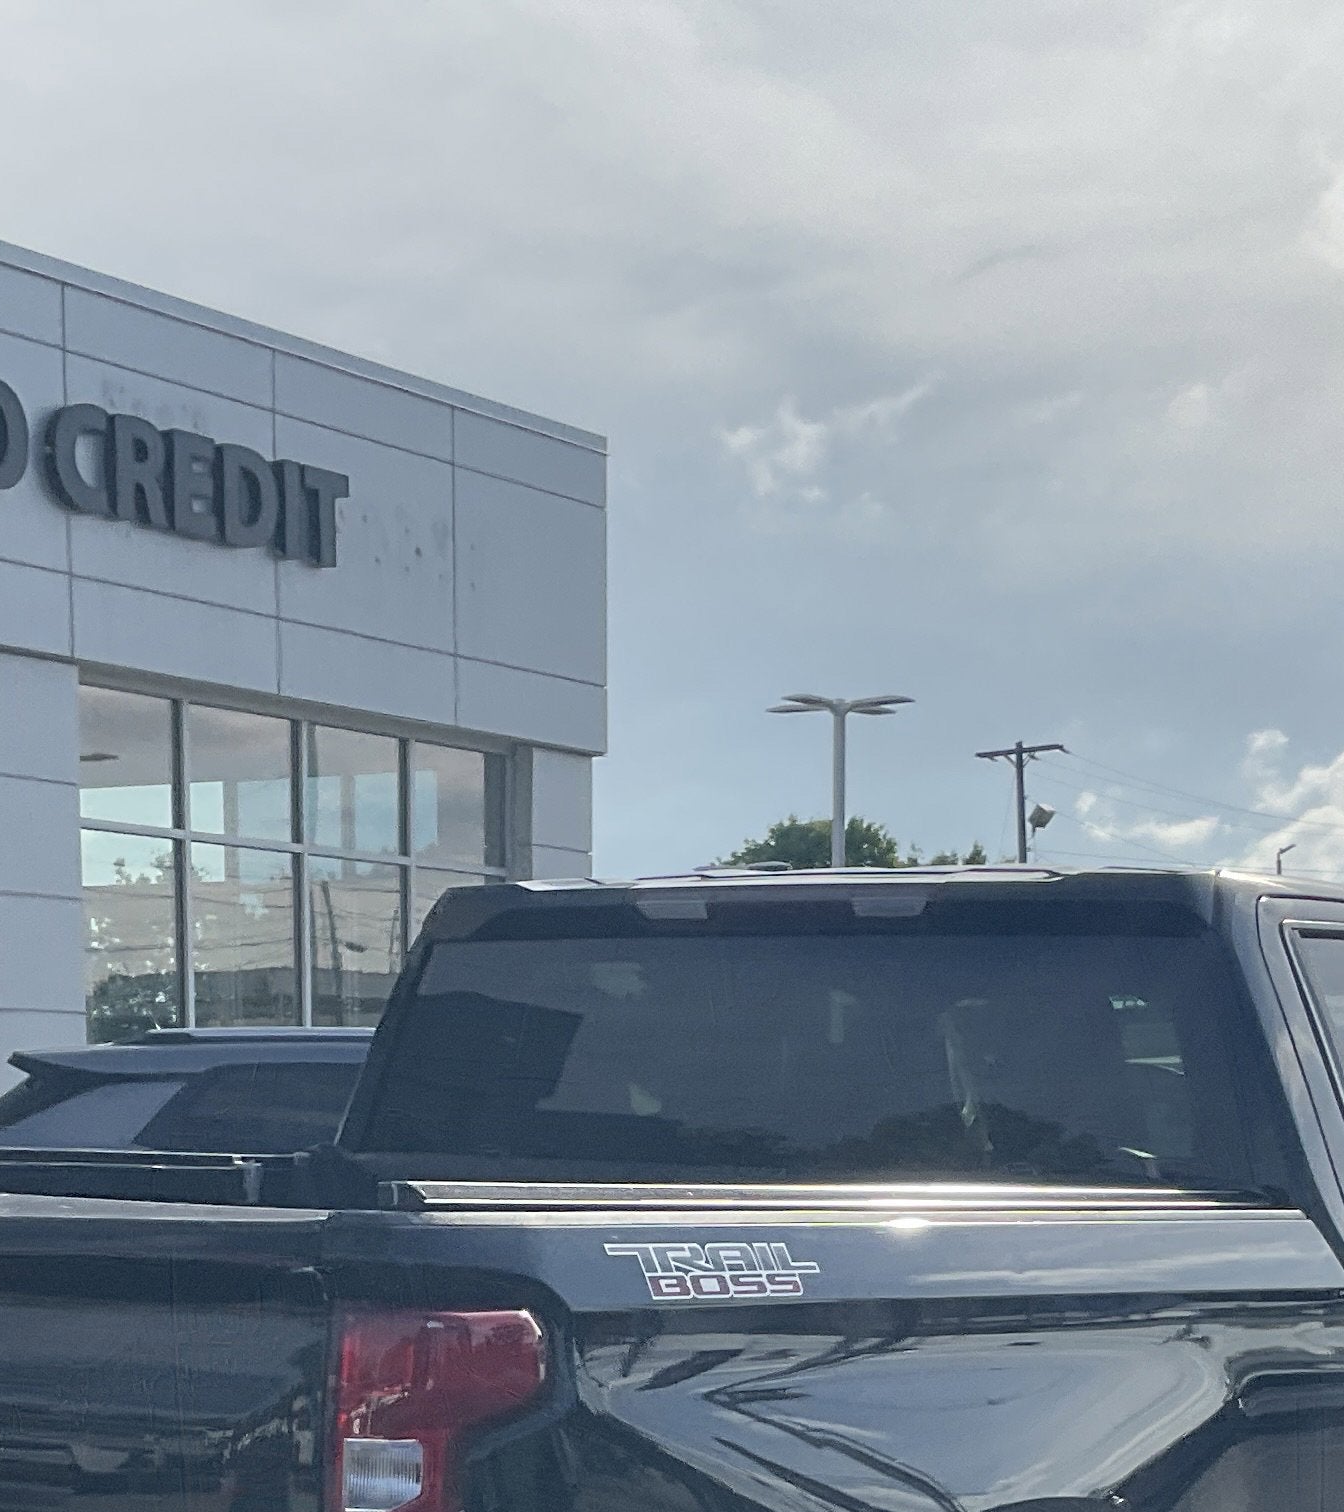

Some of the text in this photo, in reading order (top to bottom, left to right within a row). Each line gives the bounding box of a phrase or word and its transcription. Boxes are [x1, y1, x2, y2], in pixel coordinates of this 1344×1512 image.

[44, 403, 350, 569] CREDIT
[603, 1242, 820, 1273] TRAIL
[645, 1272, 804, 1300] BOSS
